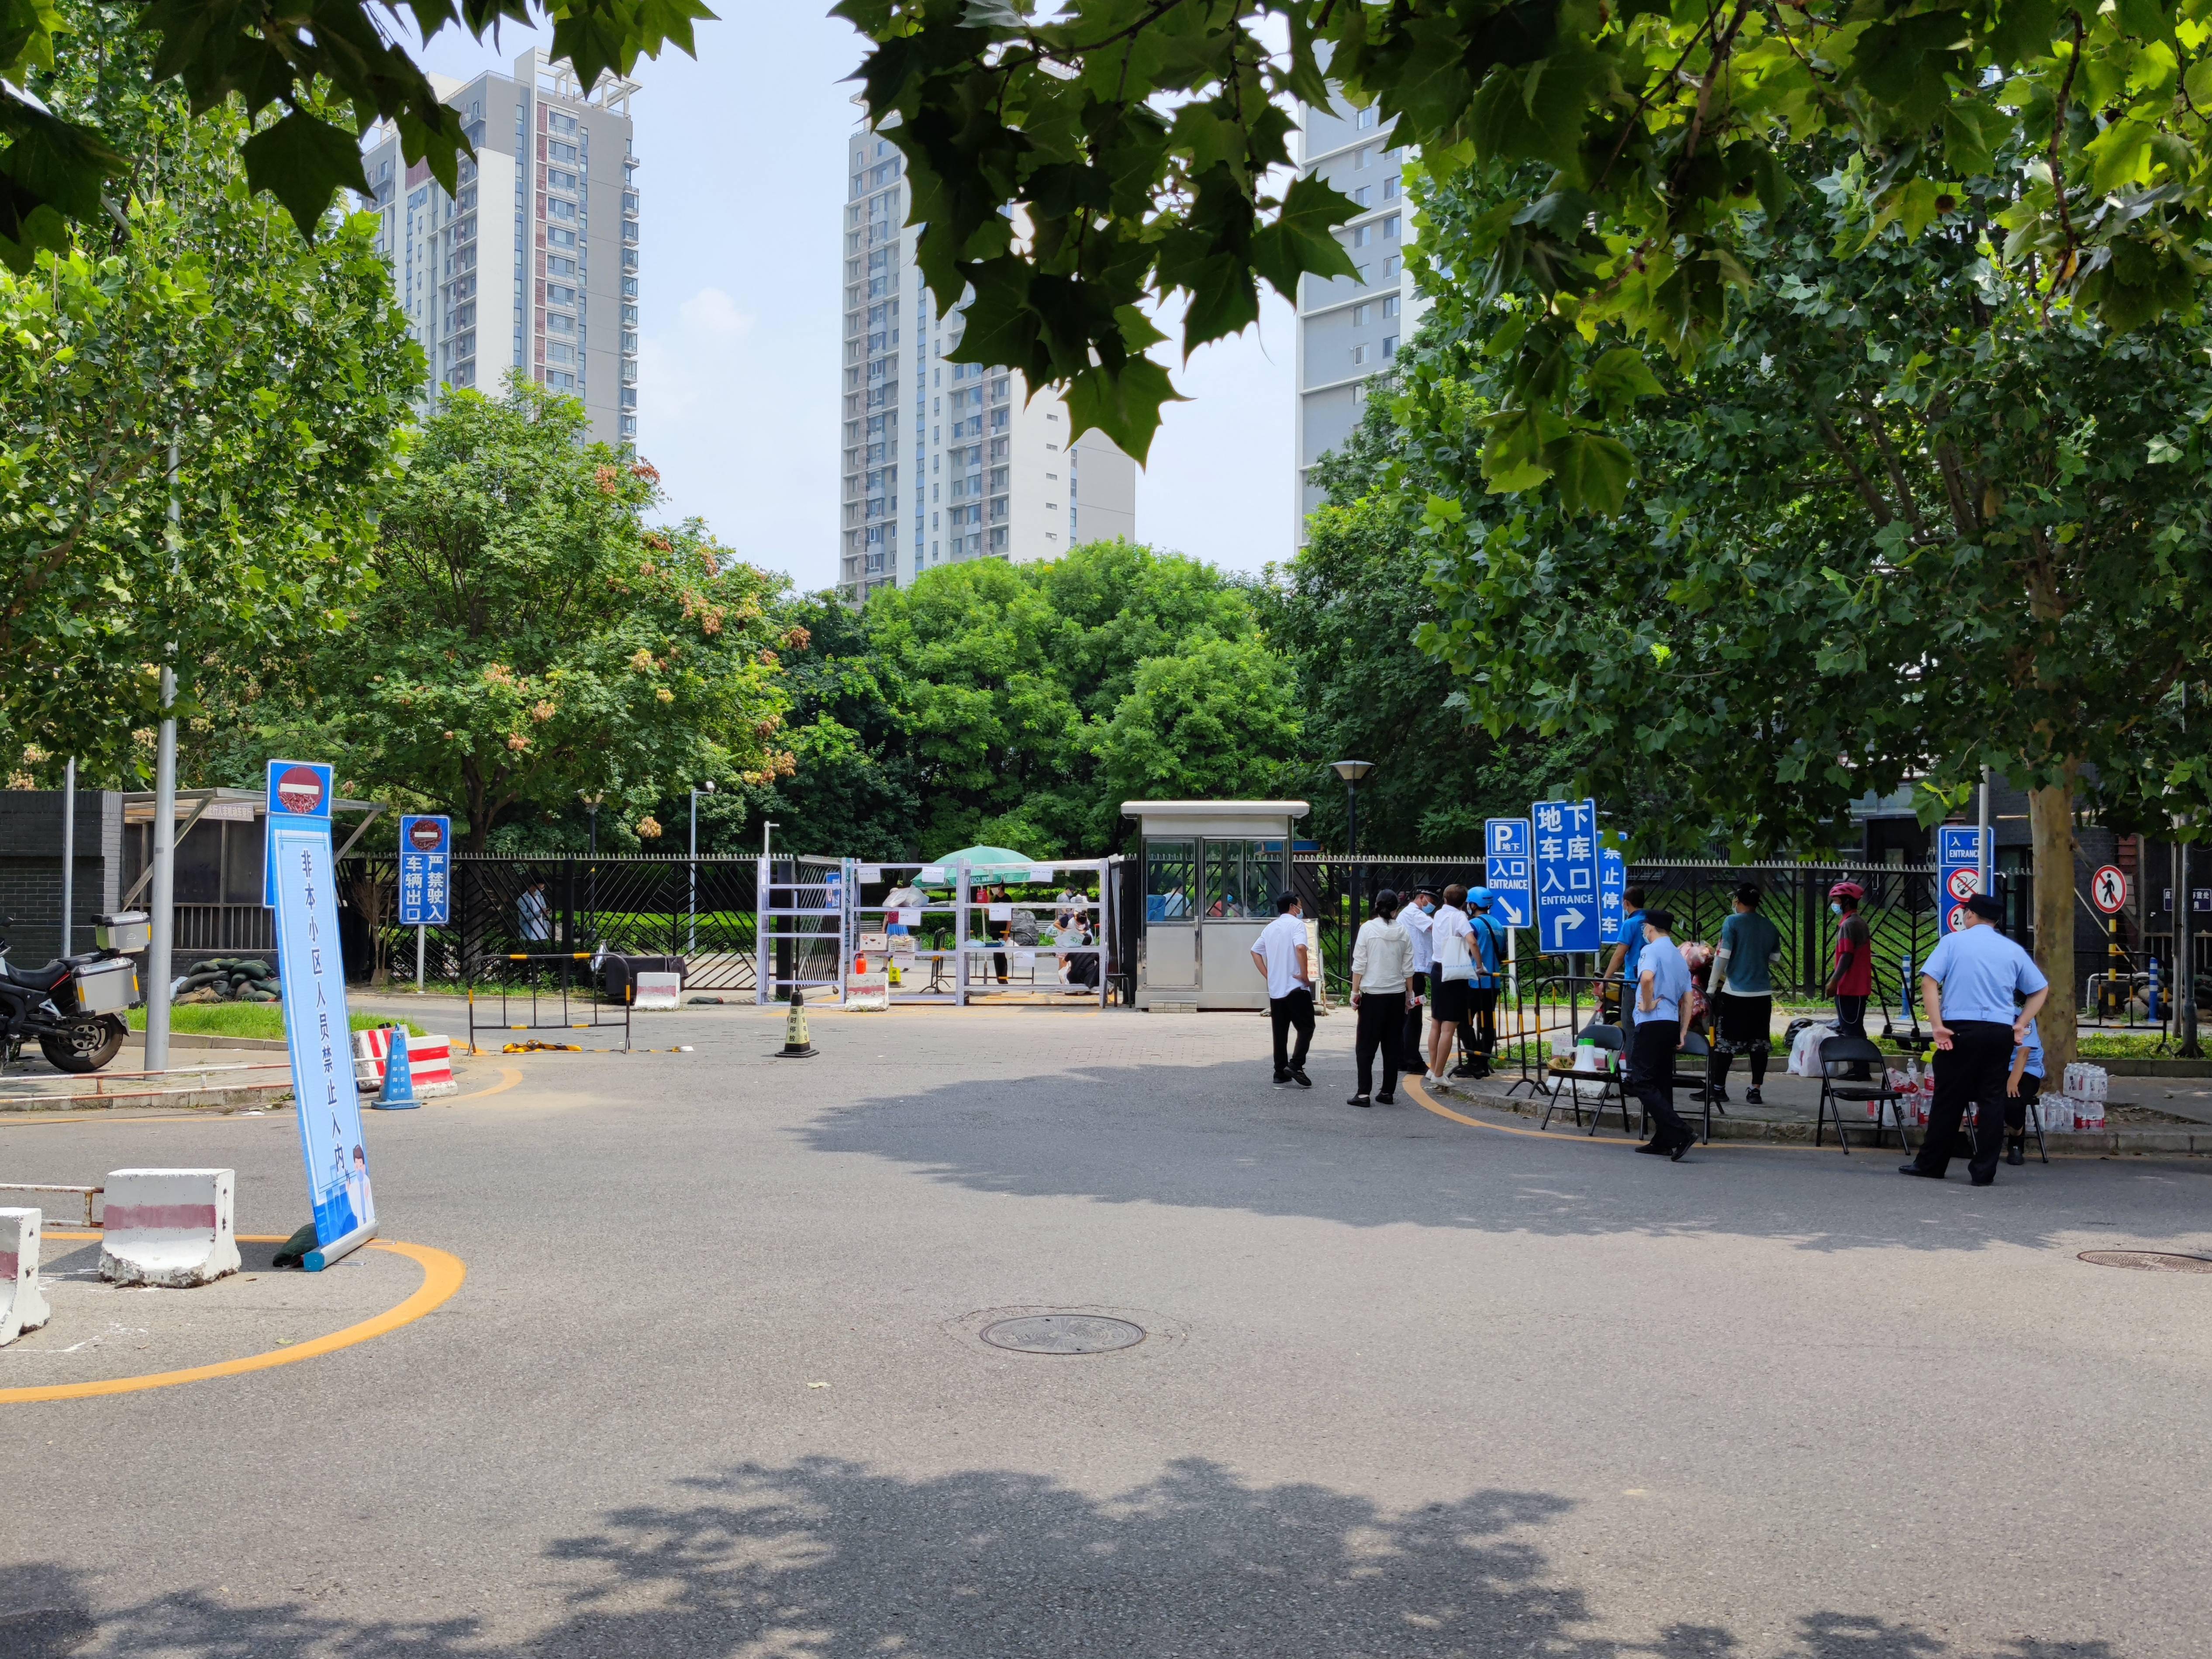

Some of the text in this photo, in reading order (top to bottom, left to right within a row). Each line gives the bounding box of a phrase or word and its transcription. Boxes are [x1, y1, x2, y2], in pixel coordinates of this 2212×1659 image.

[204, 804, 252, 818] 止行人非机动车穿行
[1538, 804, 1589, 832] 地下
[1495, 825, 1513, 851] P
[1502, 842, 1520, 851] 地下
[1539, 834, 1591, 863] 车库
[1492, 859, 1525, 877] 入口
[1541, 867, 1590, 893] 入口
[405, 855, 423, 921] 车辆出口
[427, 855, 444, 920] 严禁驶入
[1489, 879, 1528, 890] ENTRANCE
[1541, 894, 1594, 905] ENTRANCE
[301, 850, 345, 1173] 非本小区人员禁止入内
